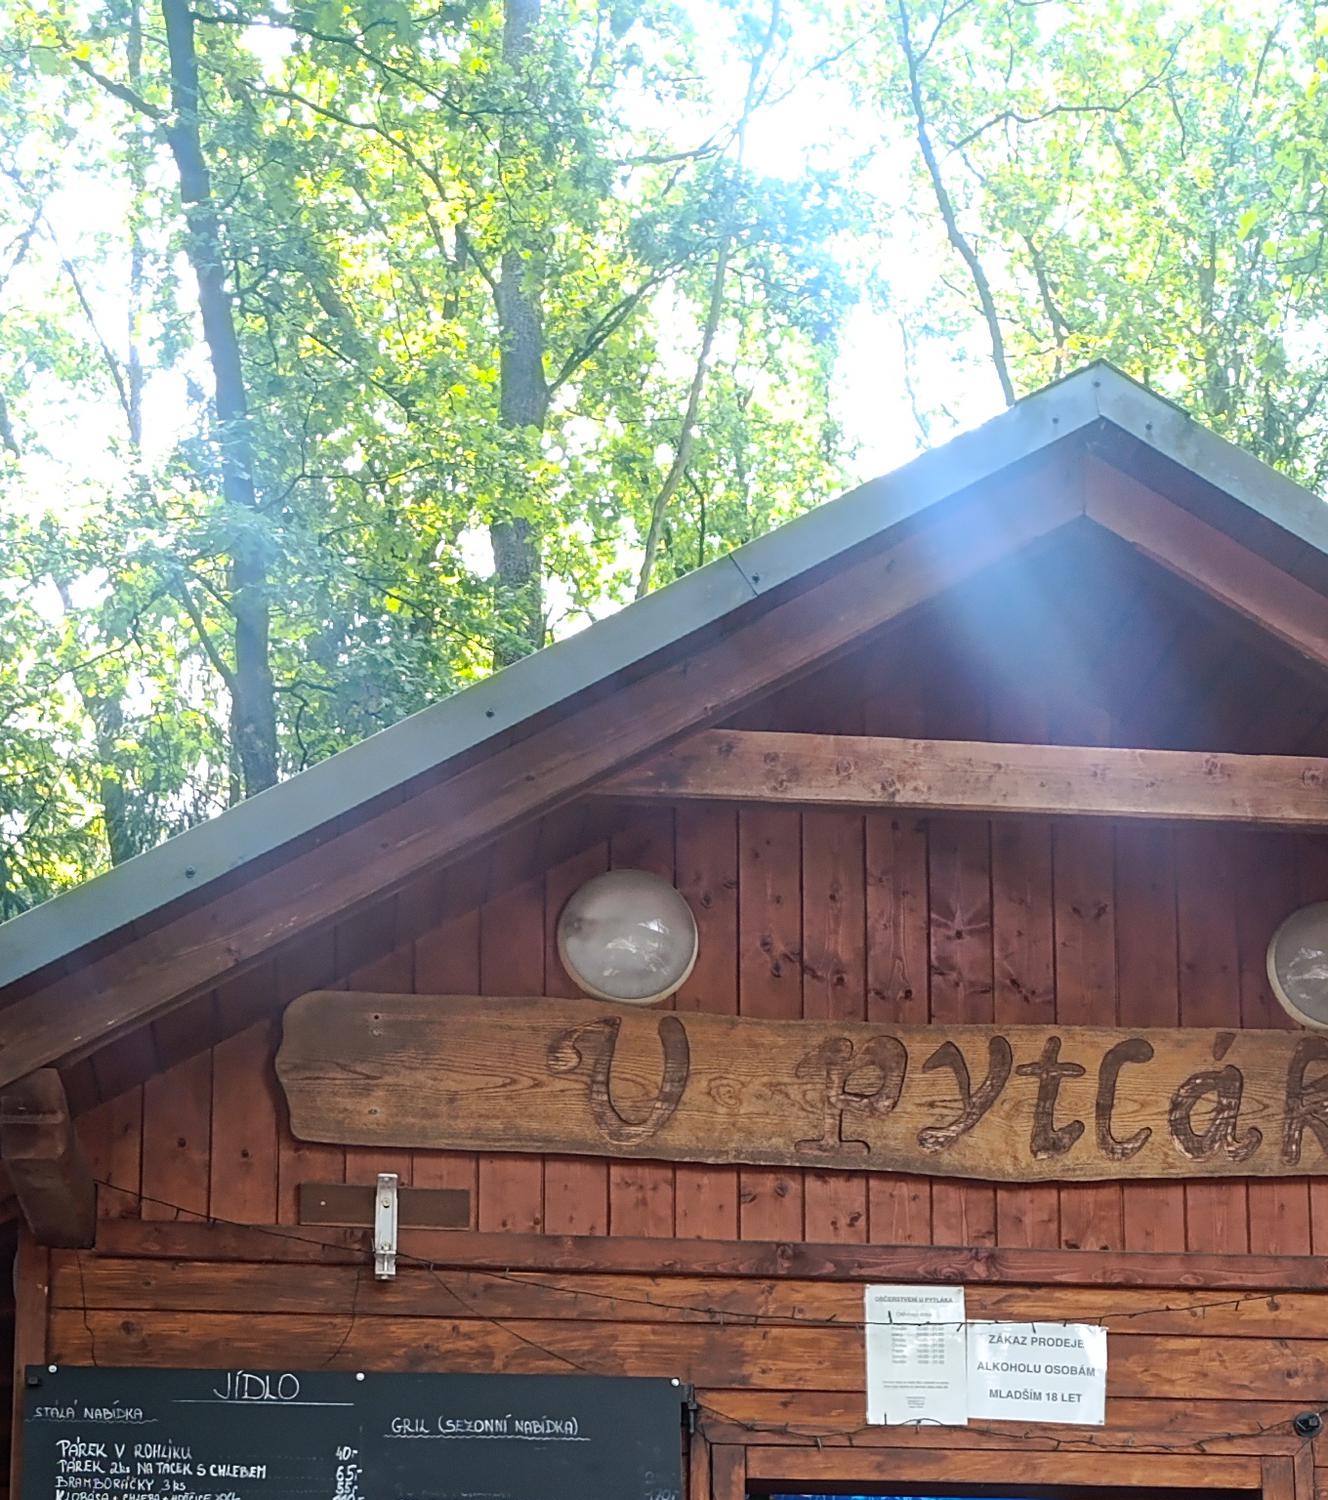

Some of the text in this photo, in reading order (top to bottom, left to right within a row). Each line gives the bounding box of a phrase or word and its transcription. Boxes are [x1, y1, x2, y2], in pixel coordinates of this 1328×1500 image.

[544, 1014, 690, 1147] U
[1031, 1337, 1084, 1348] PRODEJE
[977, 1361, 1095, 1376] ALKOHOLU OSOBÁM
[213, 1371, 300, 1400] JÍDLO
[989, 1388, 1082, 1403] MLADŠÍM 18 LET
[84, 1400, 143, 1421] NABÍDKA
[392, 1414, 578, 1435] GRIL (SEZONNÍ NABÍDKA)
[56, 1436, 106, 1459] PÁREK
[115, 1444, 125, 1458] V
[57, 1458, 105, 1473] PÁREK
[196, 1463, 206, 1476] S
[210, 1464, 266, 1479] CHLEBEM
